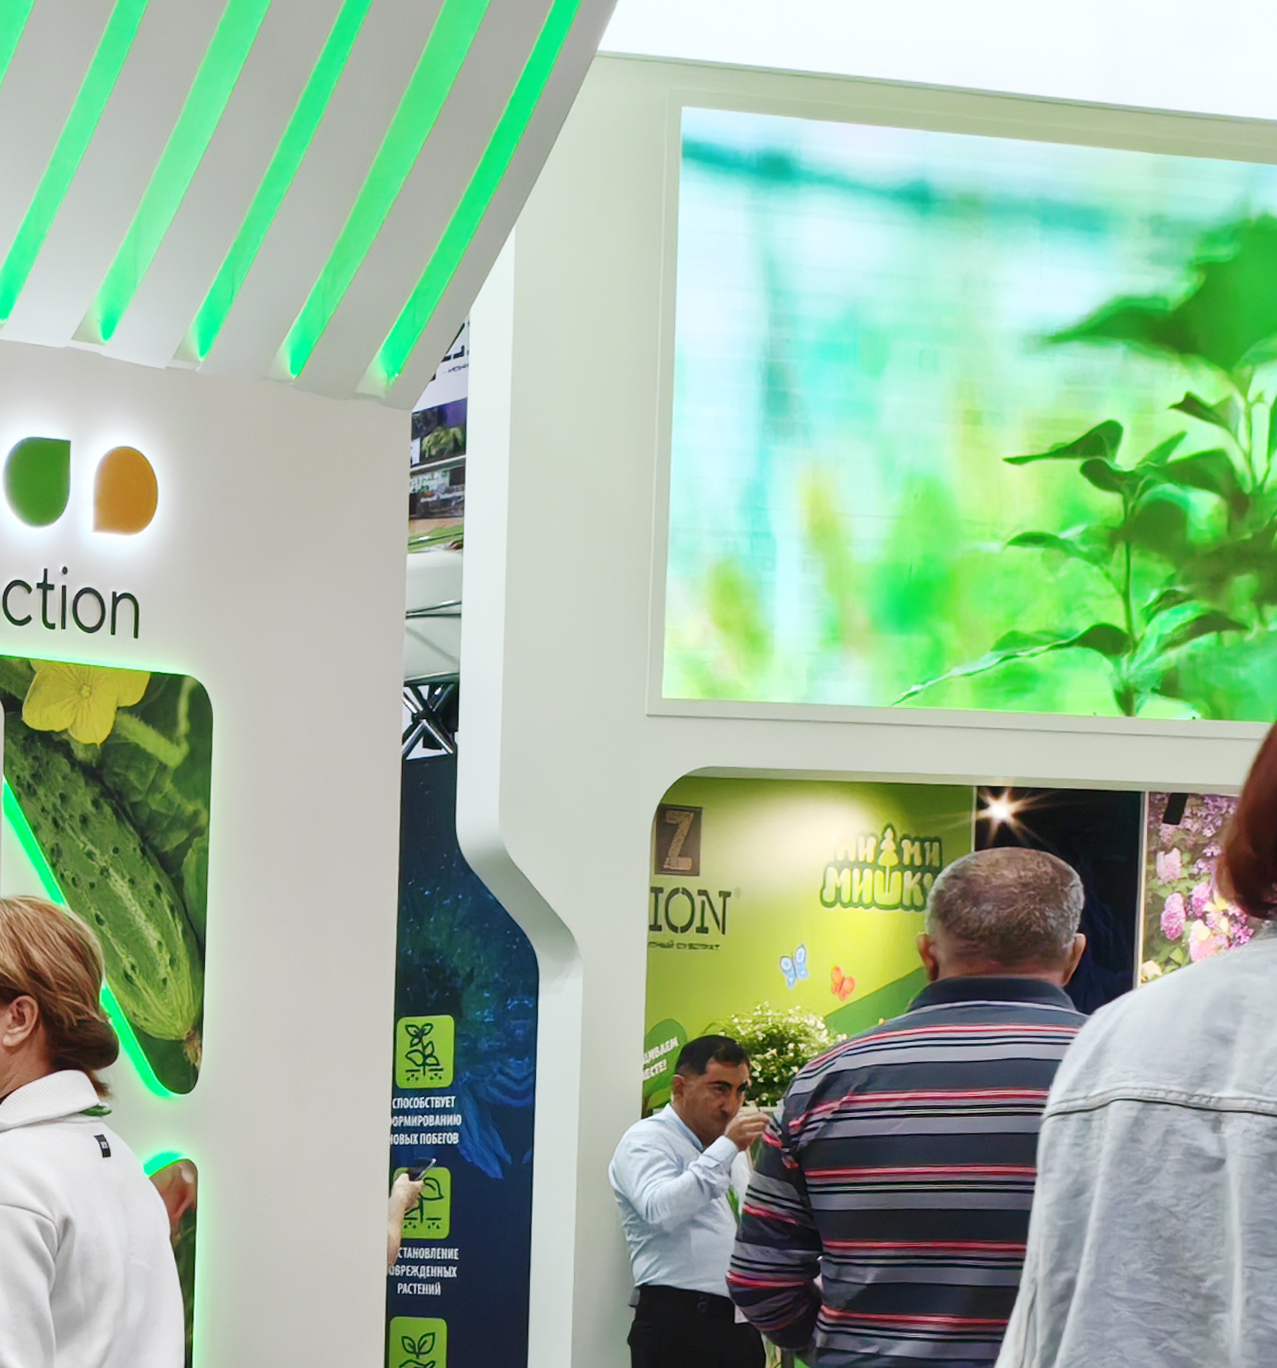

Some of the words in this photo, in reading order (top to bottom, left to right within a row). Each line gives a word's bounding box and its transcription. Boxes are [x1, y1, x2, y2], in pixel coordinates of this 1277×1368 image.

[649, 887, 731, 935] ION
[392, 1096, 456, 1109] СПОСОБСТВУЕТ
[392, 1114, 462, 1127] ОРМИРОВАНИЮ
[420, 1132, 459, 1144] ПОБЕГОВ
[397, 1247, 459, 1260] СТАНОВЛЕНИЕ
[389, 1265, 457, 1279] ОВРЕЖДЕННЫХ
[397, 1282, 441, 1295] РАСТЕНИЙ
